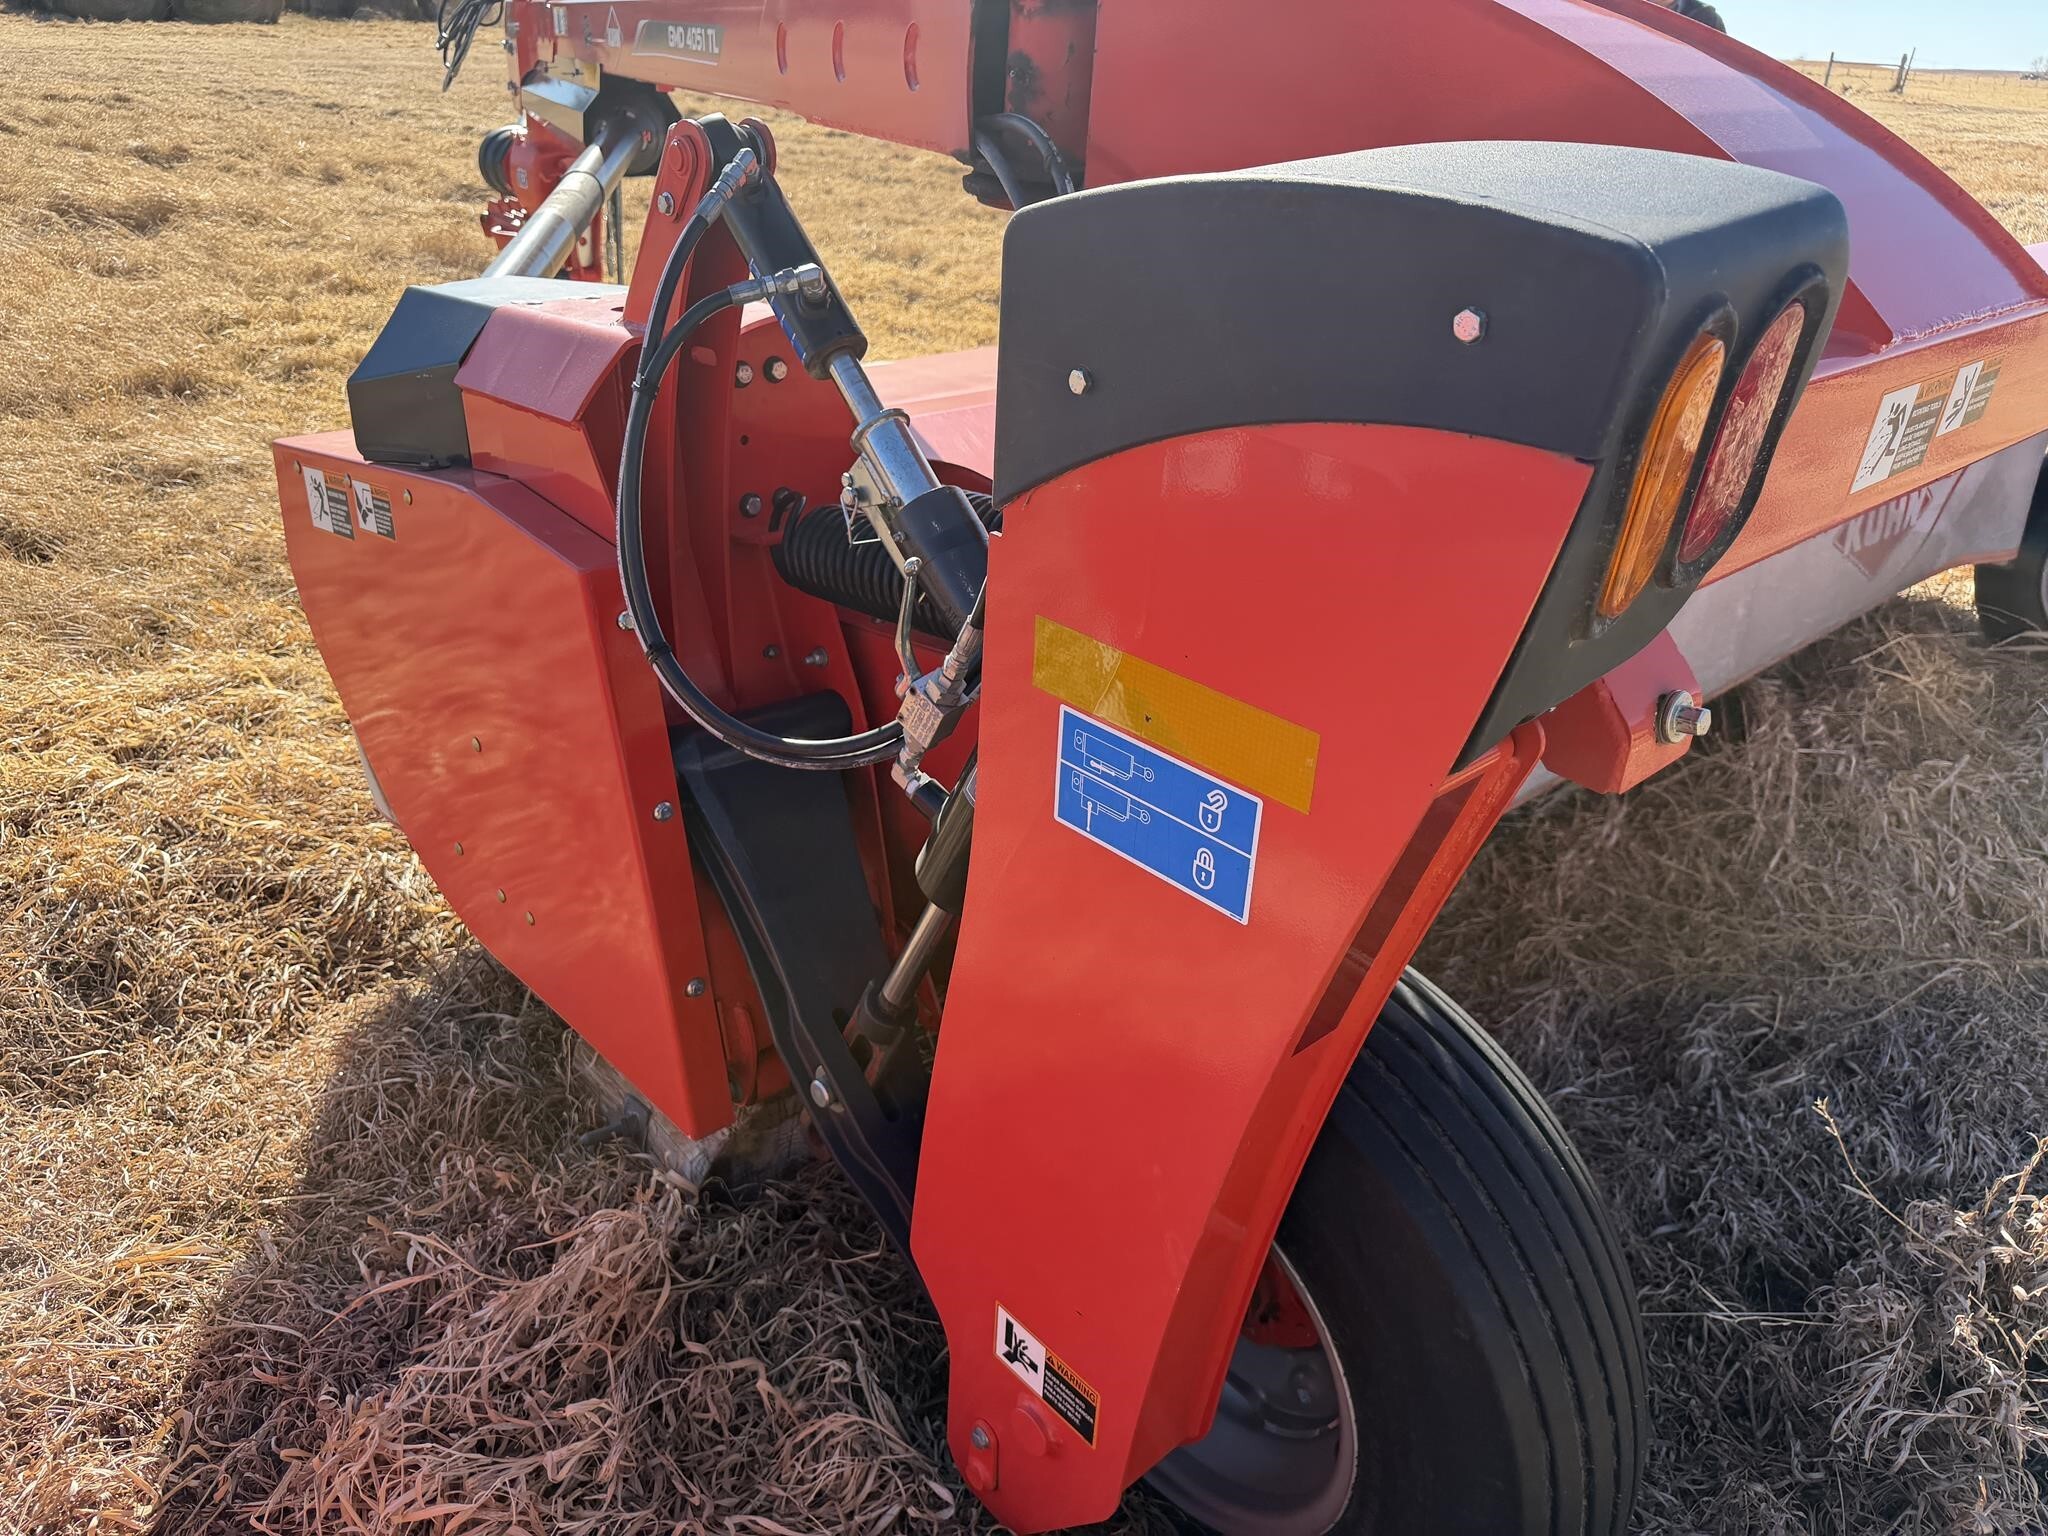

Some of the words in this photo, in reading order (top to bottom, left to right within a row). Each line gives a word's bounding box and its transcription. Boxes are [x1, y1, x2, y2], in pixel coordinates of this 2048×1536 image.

[686, 26, 706, 52] 4051
[706, 28, 720, 54] TL
[1843, 488, 1928, 555] KUHN
[1045, 1369, 1060, 1385] NEVER
[1056, 1360, 1096, 1402] WARNING
[1044, 1388, 1058, 1404] PARTS
[1045, 1375, 1054, 1386] THE
[1075, 1404, 1094, 1424] DANGER
[1056, 1393, 1063, 1402] AS
[1062, 1399, 1075, 1414] LONG
[1075, 1411, 1082, 1420] AS
